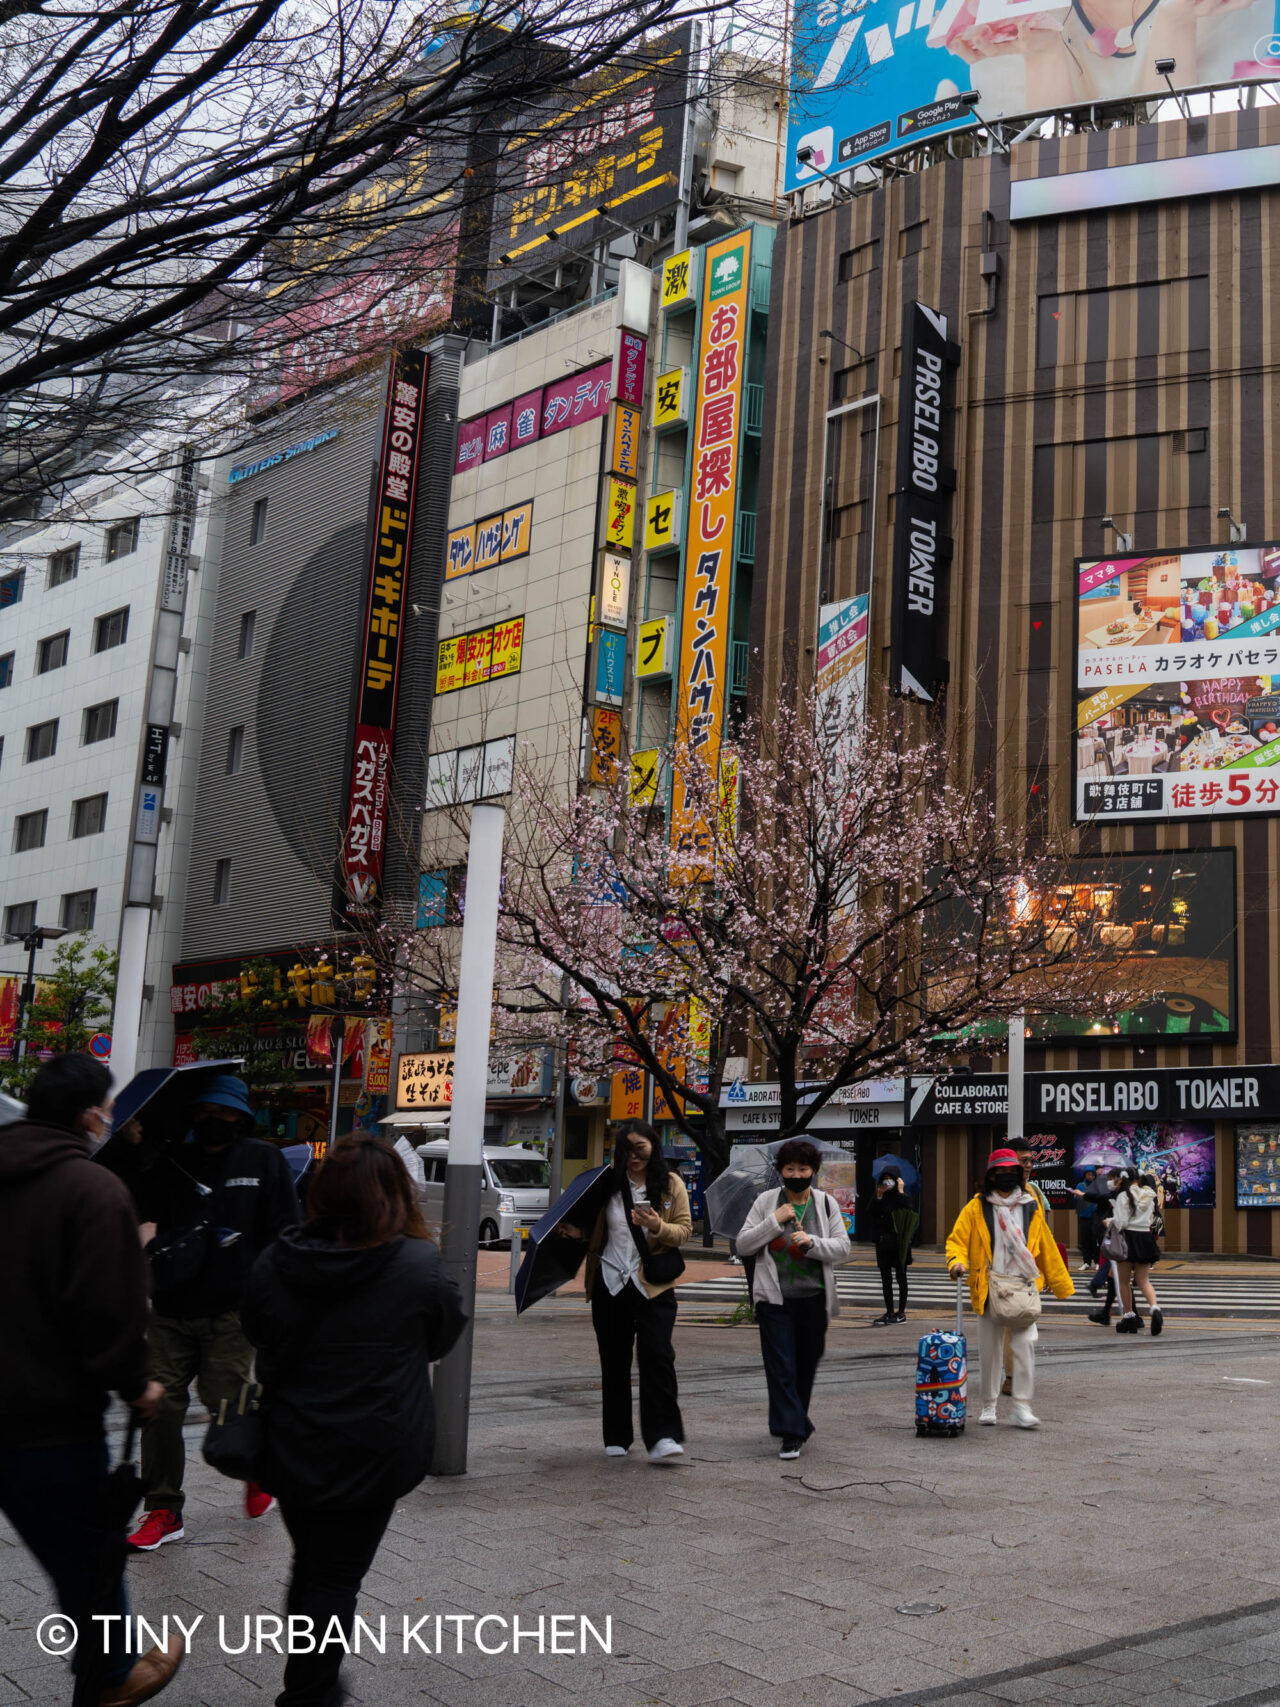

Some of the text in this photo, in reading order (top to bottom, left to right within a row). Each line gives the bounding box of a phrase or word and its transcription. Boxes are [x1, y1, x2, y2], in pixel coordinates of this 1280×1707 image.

[917, 100, 960, 121] Google Play
[854, 126, 887, 146] App Store
[712, 279, 742, 297] TOWN GROUP
[488, 408, 536, 452] 麻雀
[695, 303, 739, 542] お部屋探し
[385, 380, 419, 502] 驚安の殿堂
[908, 347, 942, 616] PASELABO TOWER
[1084, 564, 1116, 585] ママ会
[1250, 612, 1280, 634] 推し会
[1084, 661, 1147, 677] PASELA
[1202, 678, 1244, 693] HAPPY
[1085, 693, 1124, 721] パーティー
[600, 711, 617, 724] 2F
[1089, 782, 1158, 798] 歌舞伎町に
[1171, 772, 1280, 809] 徒歩5分
[347, 740, 377, 866] ベガスベガス
[1104, 796, 1143, 810] 3店舗
[935, 1085, 1008, 1098] COLLABORATI
[1041, 1077, 1260, 1112] PASELABO TOWER
[627, 1102, 640, 1114] 2F
[848, 1108, 880, 1124] TOWER
[935, 1101, 1009, 1115] CAFE & STORE
[742, 1113, 760, 1125] CAFE
[1041, 1179, 1067, 1190] TOWER
